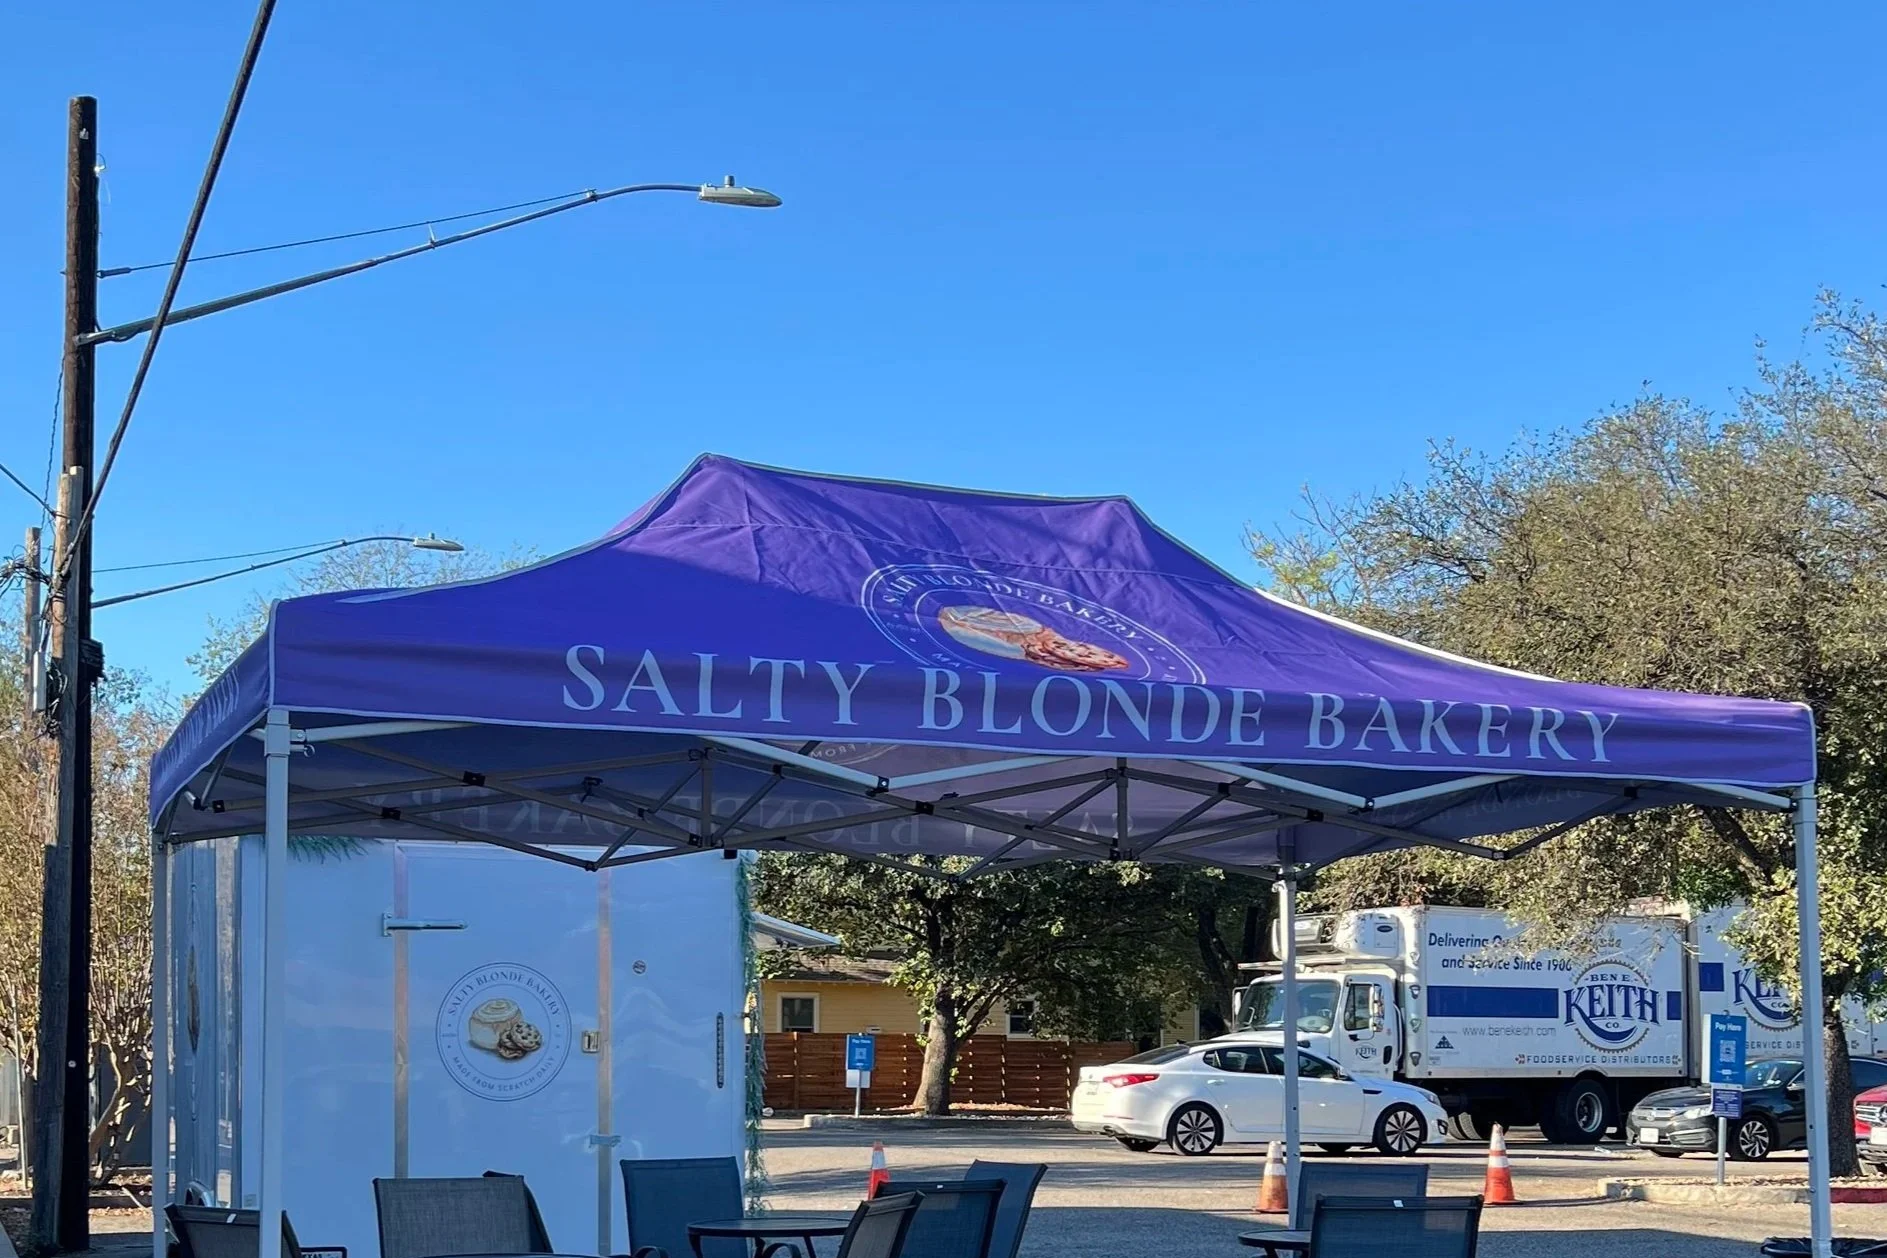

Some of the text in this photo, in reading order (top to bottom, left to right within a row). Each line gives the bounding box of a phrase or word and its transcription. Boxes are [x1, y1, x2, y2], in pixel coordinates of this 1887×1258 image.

[1040, 594, 1143, 640] BAKERY
[561, 643, 1622, 763] SALTY BLONDE BAKERY
[1442, 954, 1464, 969] and
[1513, 956, 1542, 970] Since
[1591, 973, 1617, 982] BEN
[448, 971, 561, 1016] SALTY BLONDE BAKERY
[1564, 984, 1660, 1030] KEITH
[1714, 1022, 1742, 1032] Pay Here
[453, 1055, 472, 1077] MADE
[471, 1074, 495, 1090] FROM
[497, 1073, 536, 1092] SCRATCH
[1527, 1055, 1671, 1064] FOODSERVICE DISTRIBUTORS
